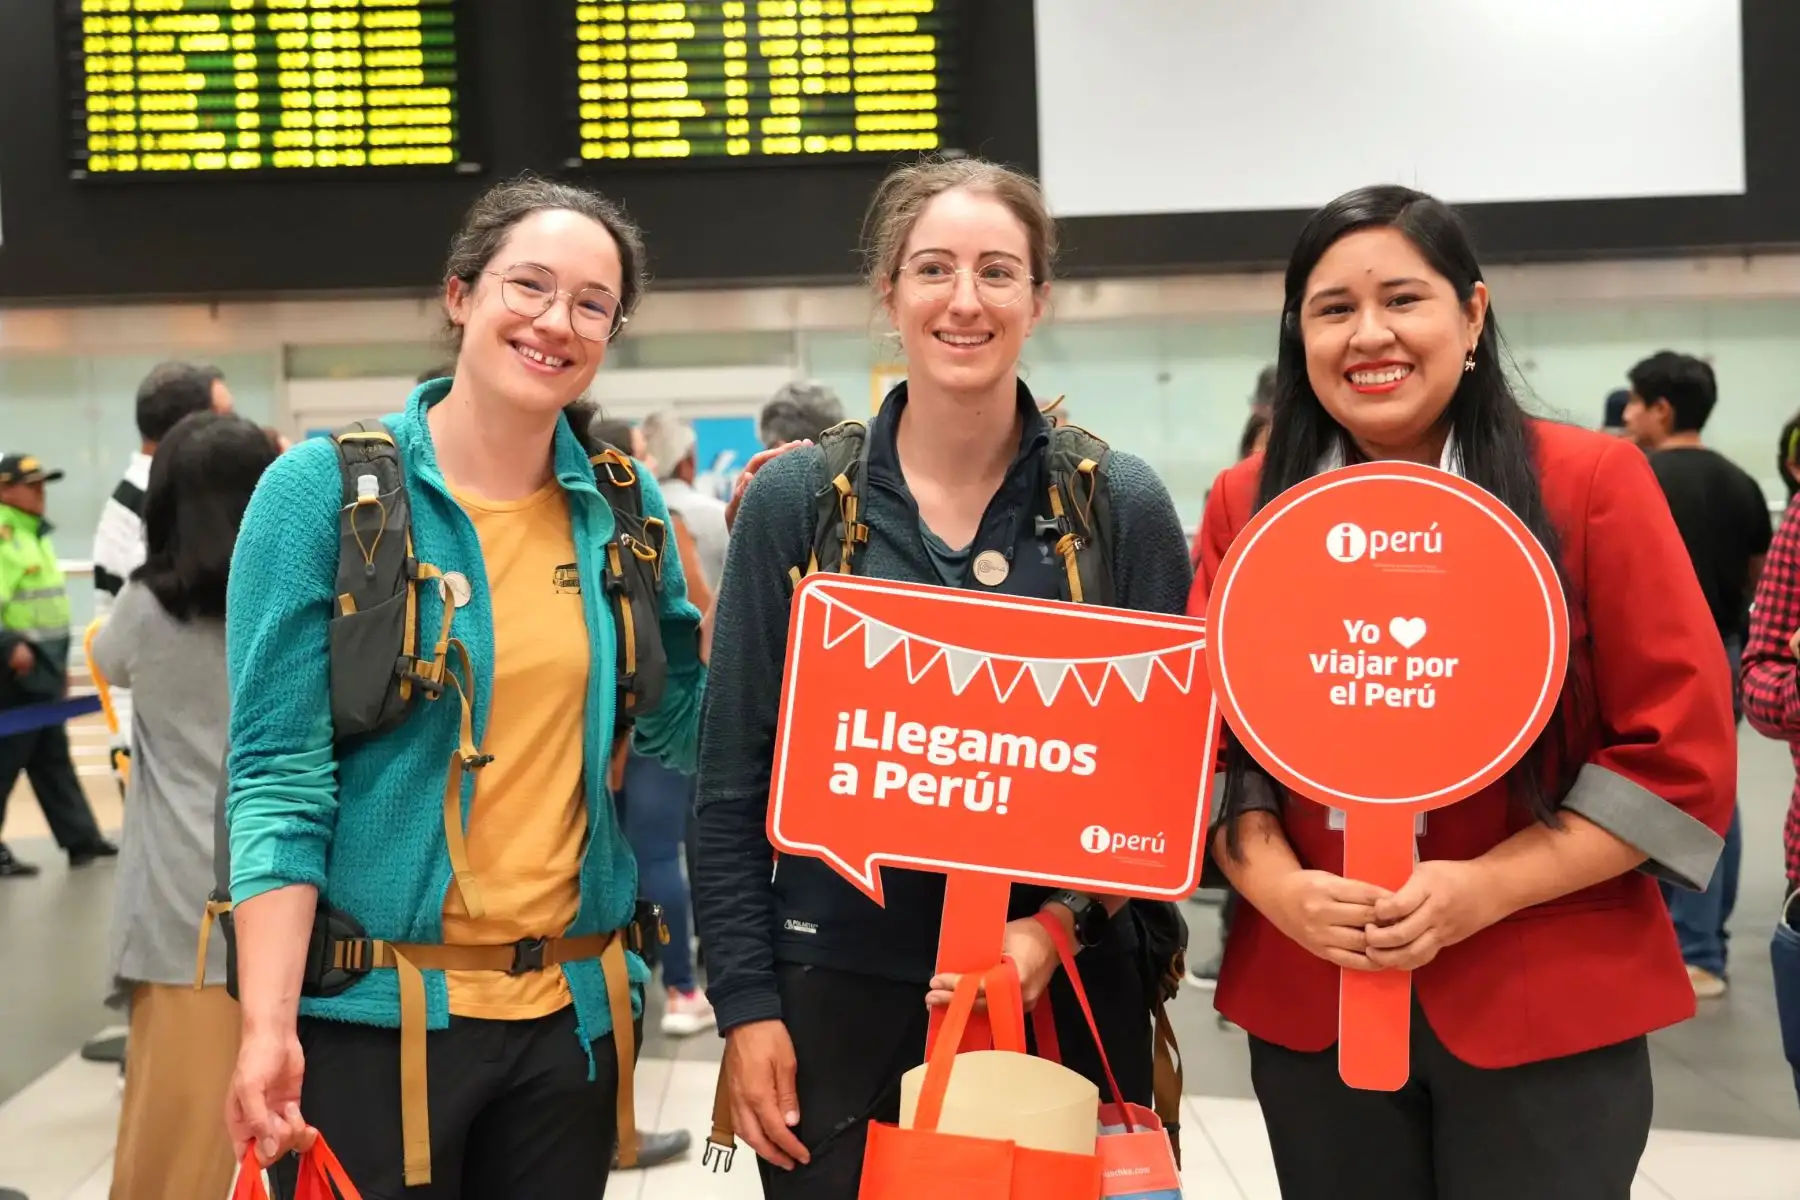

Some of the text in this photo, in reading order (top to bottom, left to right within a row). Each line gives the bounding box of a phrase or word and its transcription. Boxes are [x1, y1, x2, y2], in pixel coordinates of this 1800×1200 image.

[1343, 619, 1381, 644] Yo
[1309, 648, 1459, 681] viajar por
[1329, 680, 1436, 709] el Perú
[834, 708, 1098, 776] ¡Llegamos
[828, 760, 1012, 815] a Perú!
